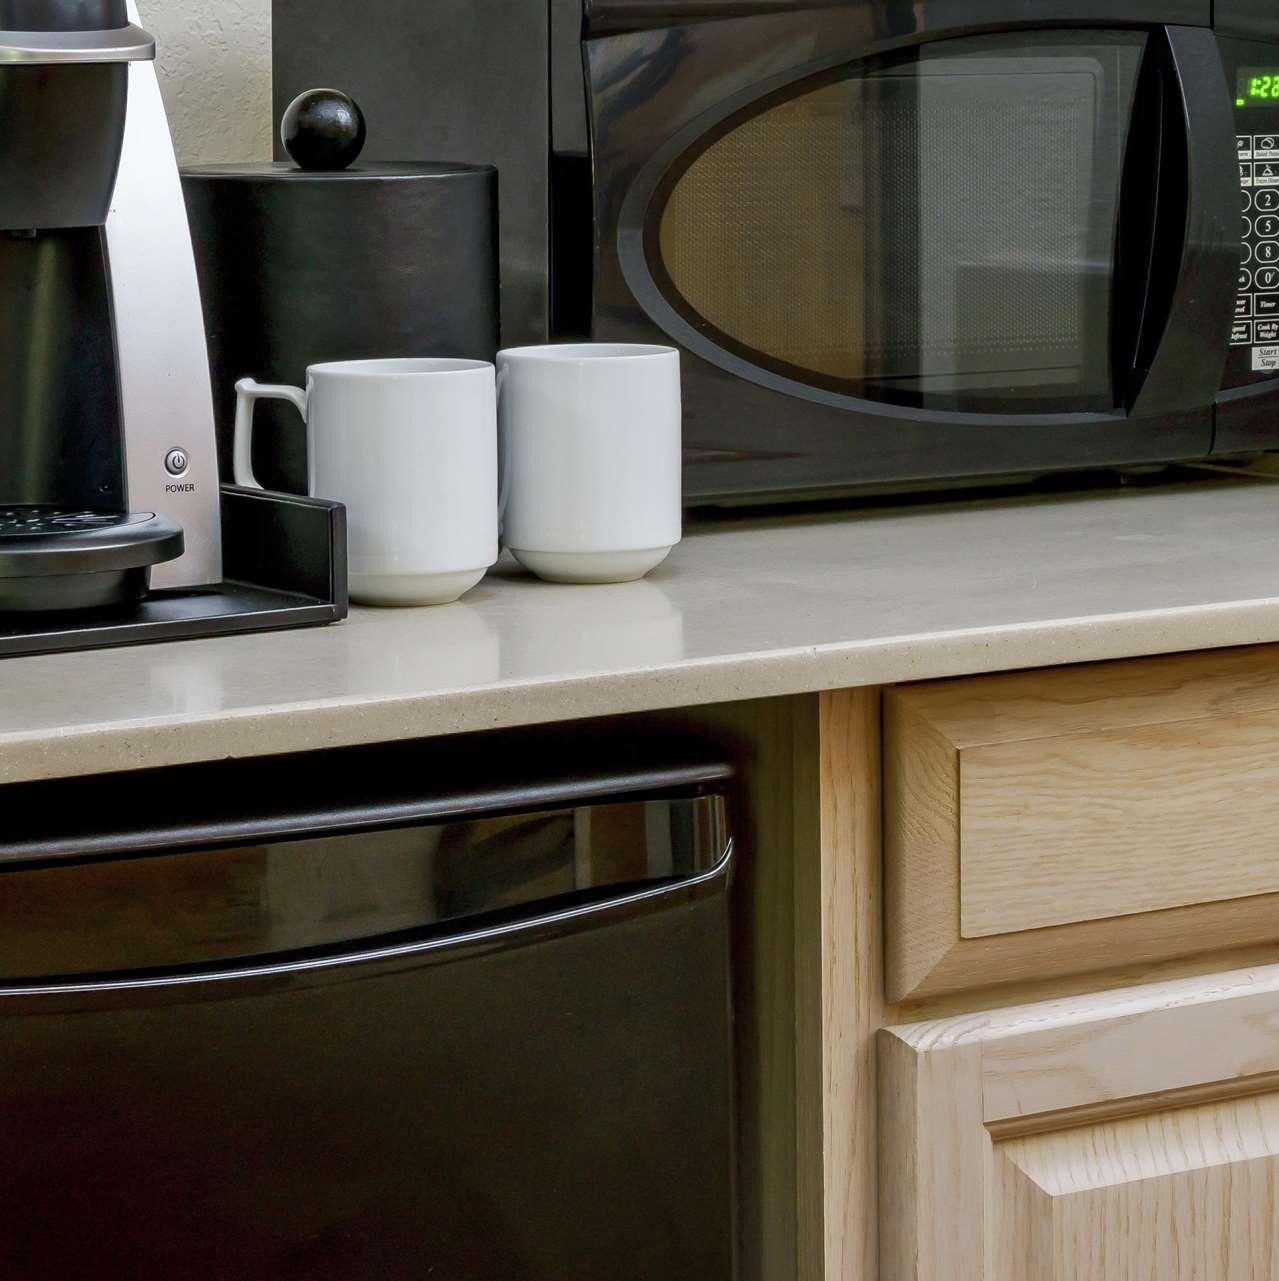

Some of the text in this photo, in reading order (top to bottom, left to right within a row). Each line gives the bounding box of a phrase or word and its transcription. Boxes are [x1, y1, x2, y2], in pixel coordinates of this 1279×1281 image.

[1264, 194, 1271, 206] 2
[1265, 220, 1271, 232] 5
[1265, 246, 1272, 258] 8
[1260, 300, 1276, 308] Timer
[1259, 348, 1277, 356] Start
[1261, 358, 1277, 368] Stop
[165, 483, 195, 493] POWER
